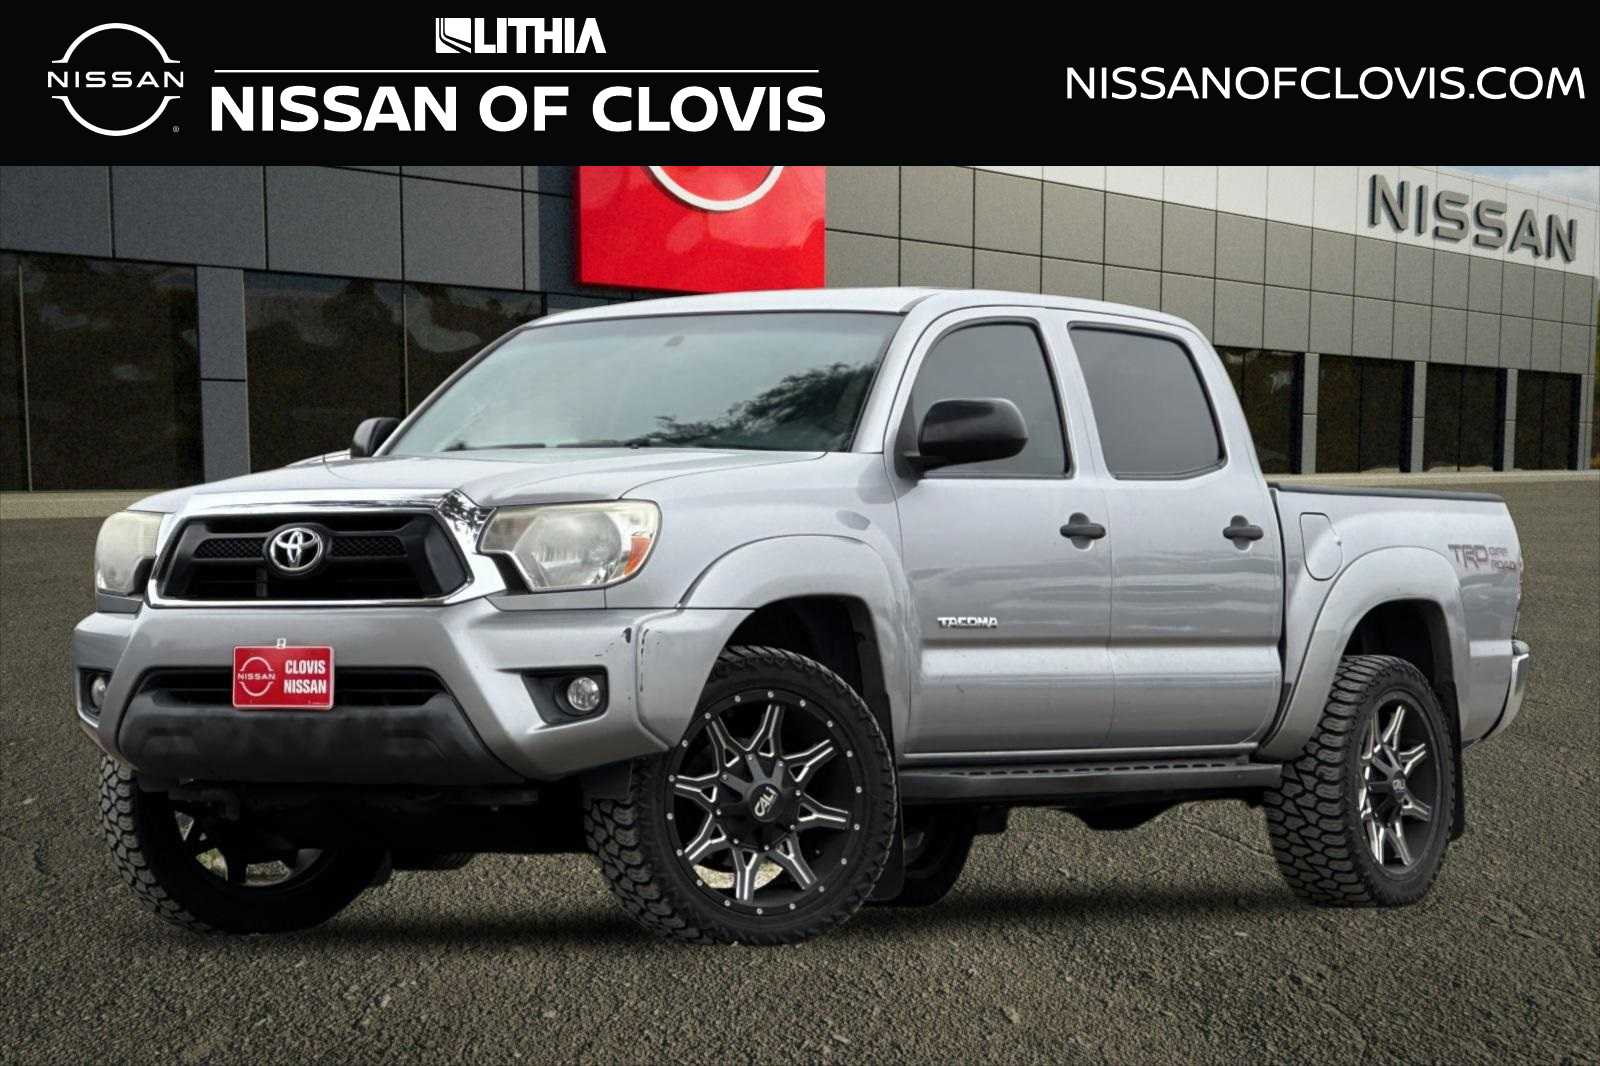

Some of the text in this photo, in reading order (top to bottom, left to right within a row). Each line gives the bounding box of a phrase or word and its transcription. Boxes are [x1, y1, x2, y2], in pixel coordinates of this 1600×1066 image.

[1367, 174, 1578, 263] NISSAN
[1447, 544, 1489, 568] TRD
[937, 616, 998, 627] TACOMA
[284, 659, 326, 675] CLOVIS
[237, 672, 276, 680] NISSAN
[283, 679, 327, 694] NISSAN
